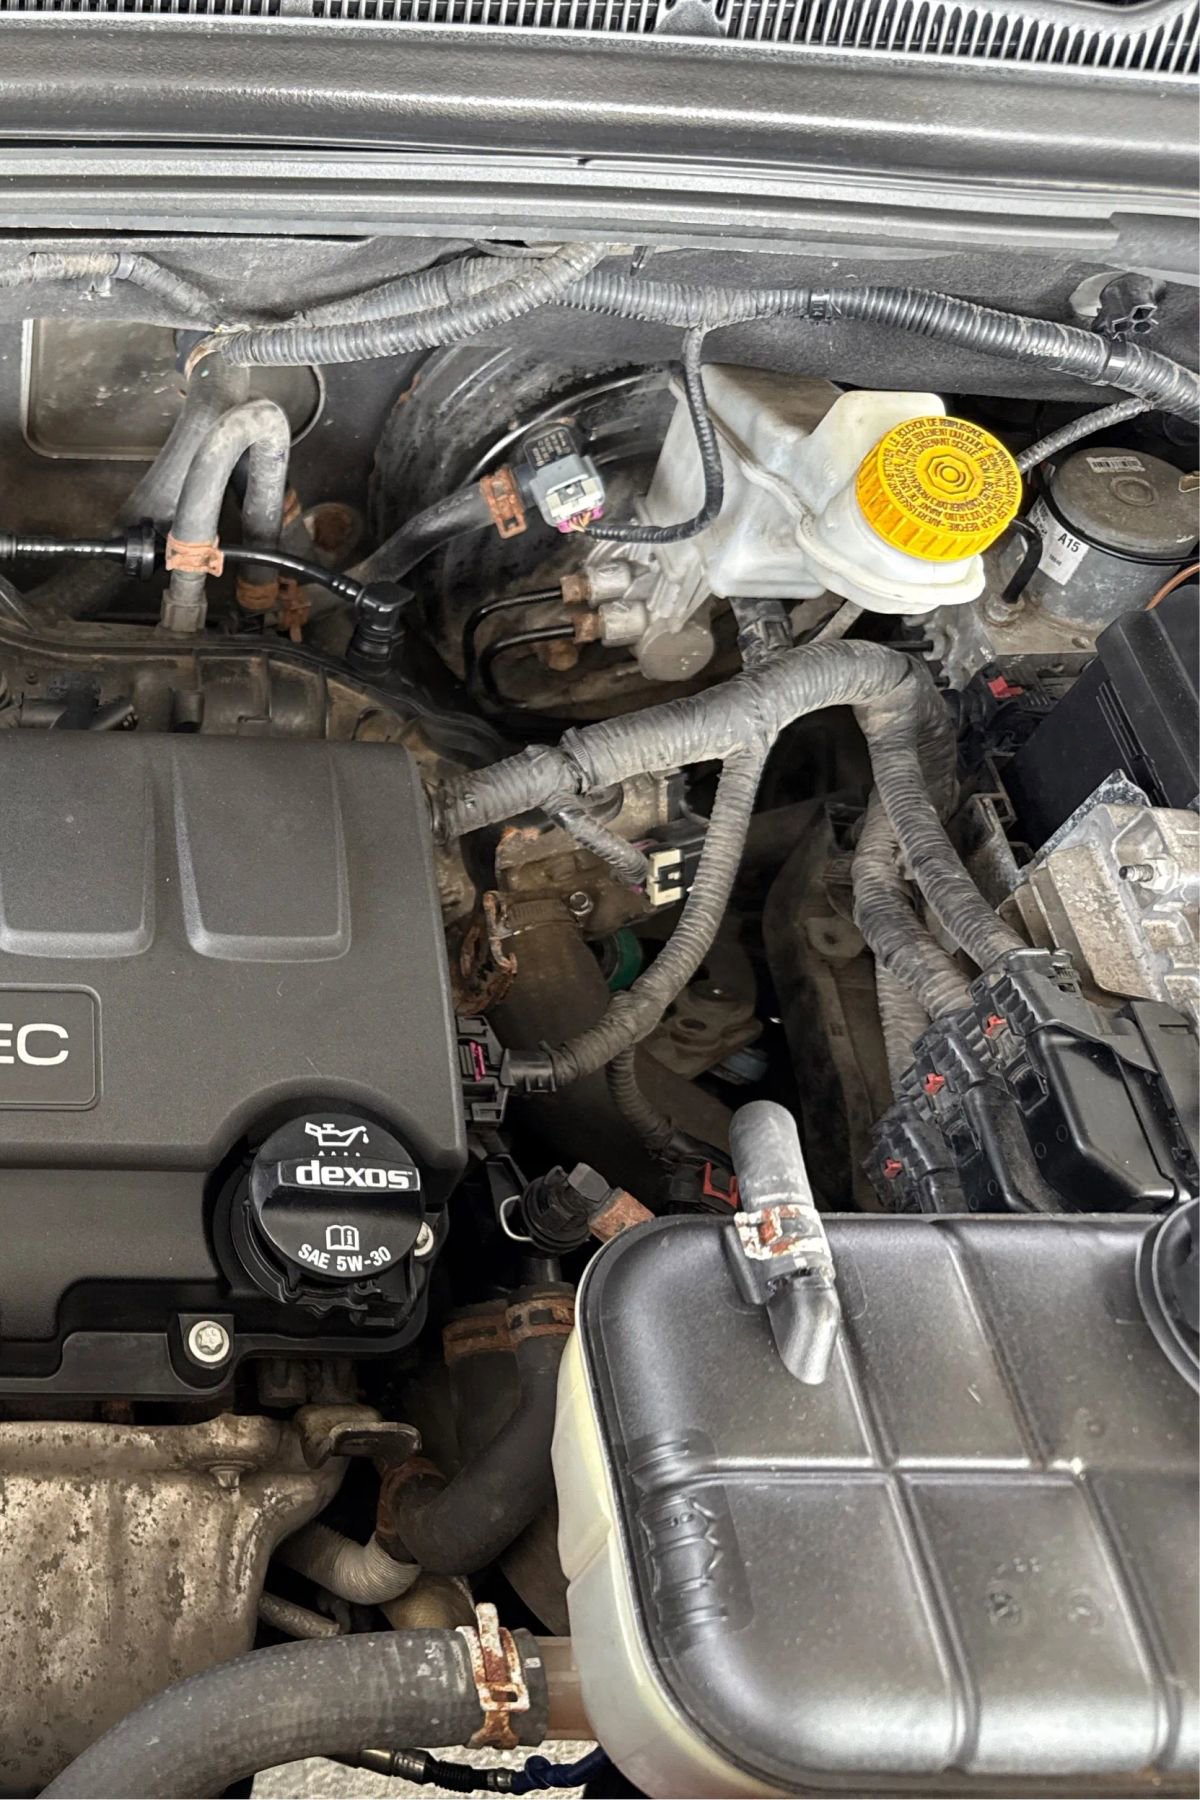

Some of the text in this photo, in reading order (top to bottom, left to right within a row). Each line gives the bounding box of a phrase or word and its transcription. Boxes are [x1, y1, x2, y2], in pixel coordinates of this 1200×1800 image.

[978, 515, 999, 529] CAP
[1057, 533, 1081, 553] A15
[298, 1244, 392, 1272] SAE 5W-30
